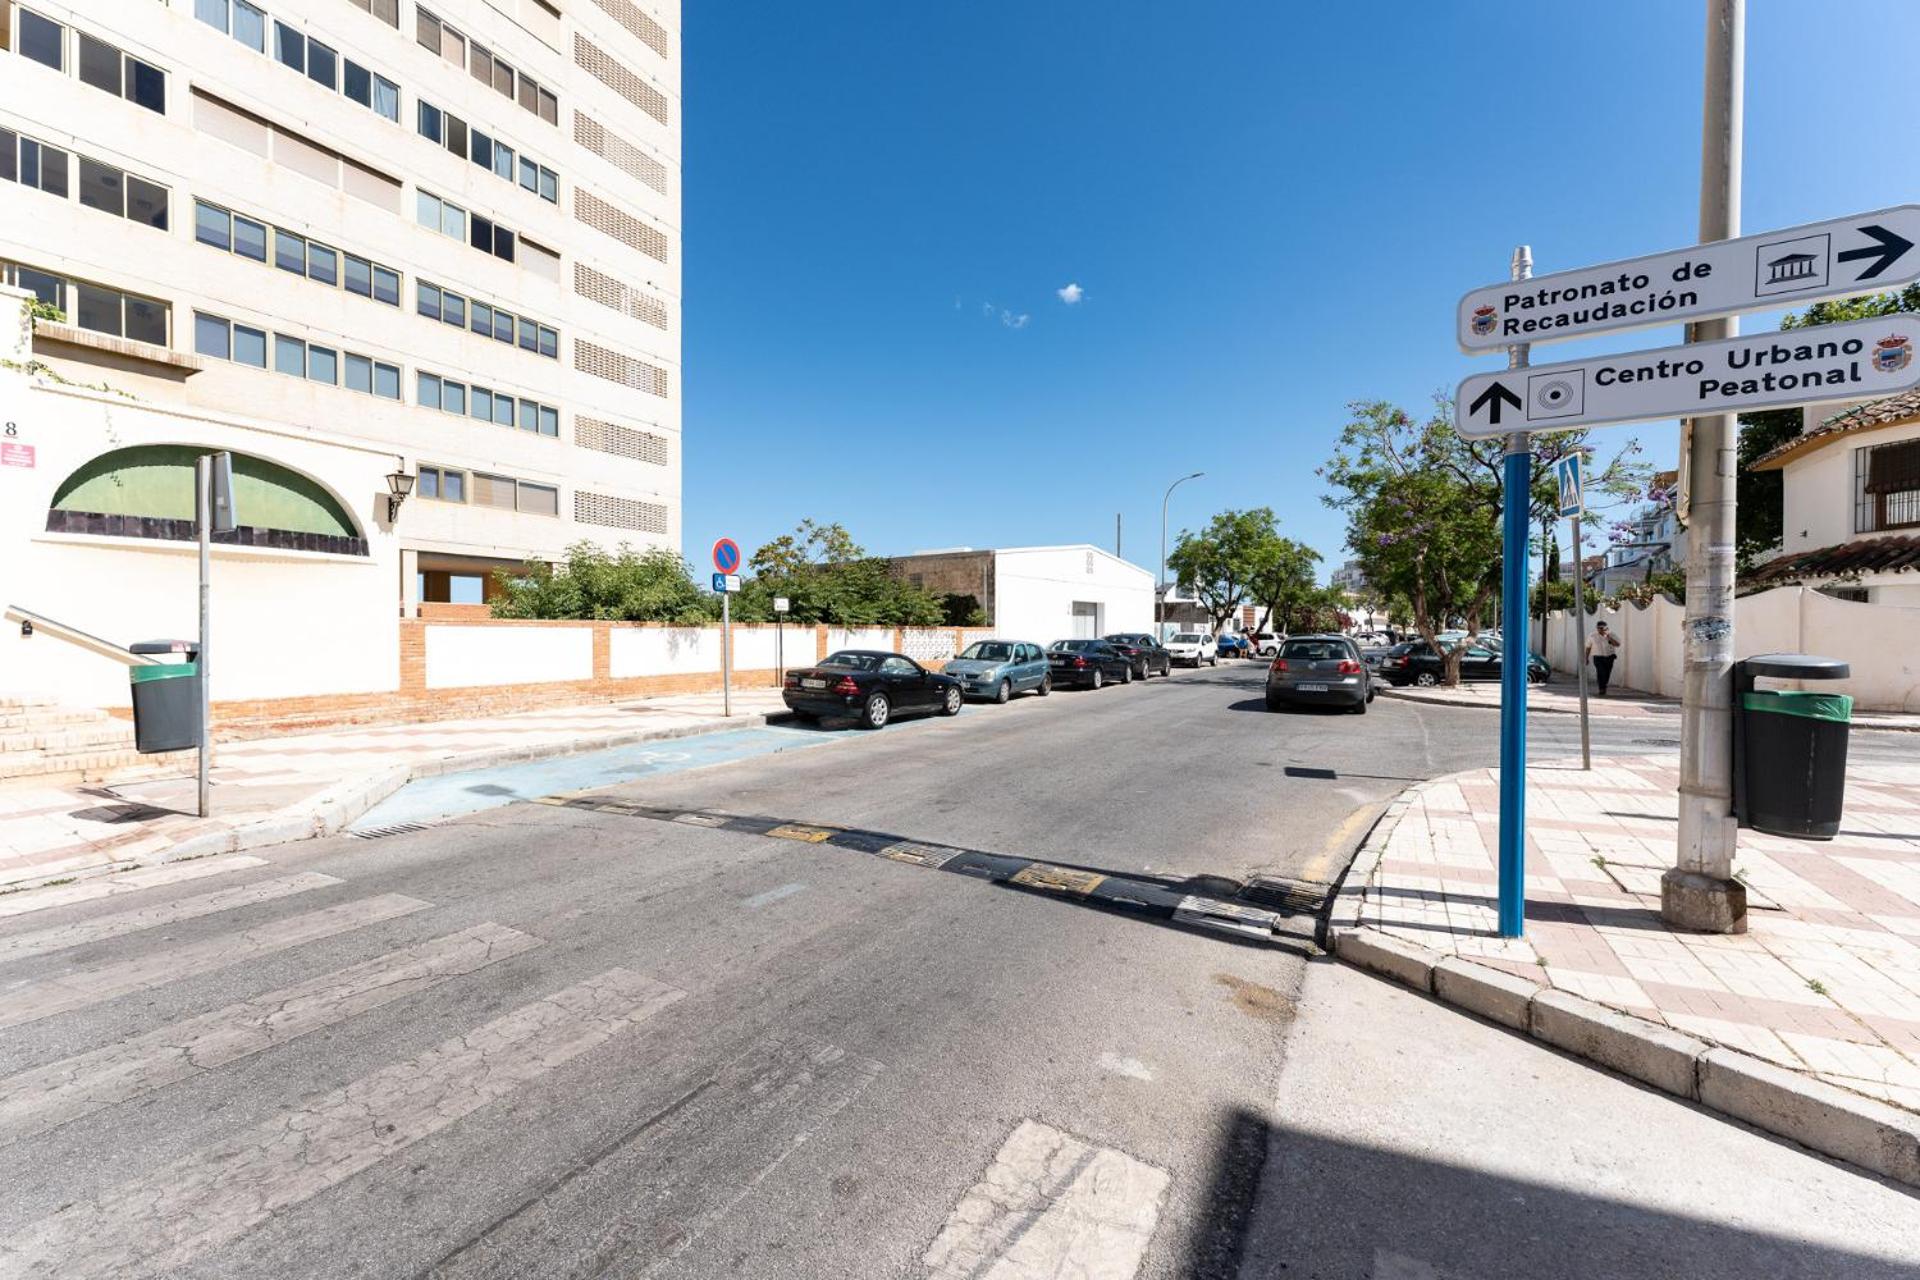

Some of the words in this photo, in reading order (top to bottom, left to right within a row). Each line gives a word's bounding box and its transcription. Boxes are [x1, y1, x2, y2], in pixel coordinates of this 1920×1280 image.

[1504, 273, 1650, 313] Patronato
[1672, 261, 1712, 283] de
[1503, 290, 1698, 337] Recaudación
[1595, 359, 1705, 387] Centro
[1727, 338, 1864, 370] Urbano
[1699, 361, 1862, 400] Peatonal
[5, 421, 17, 436] 8
